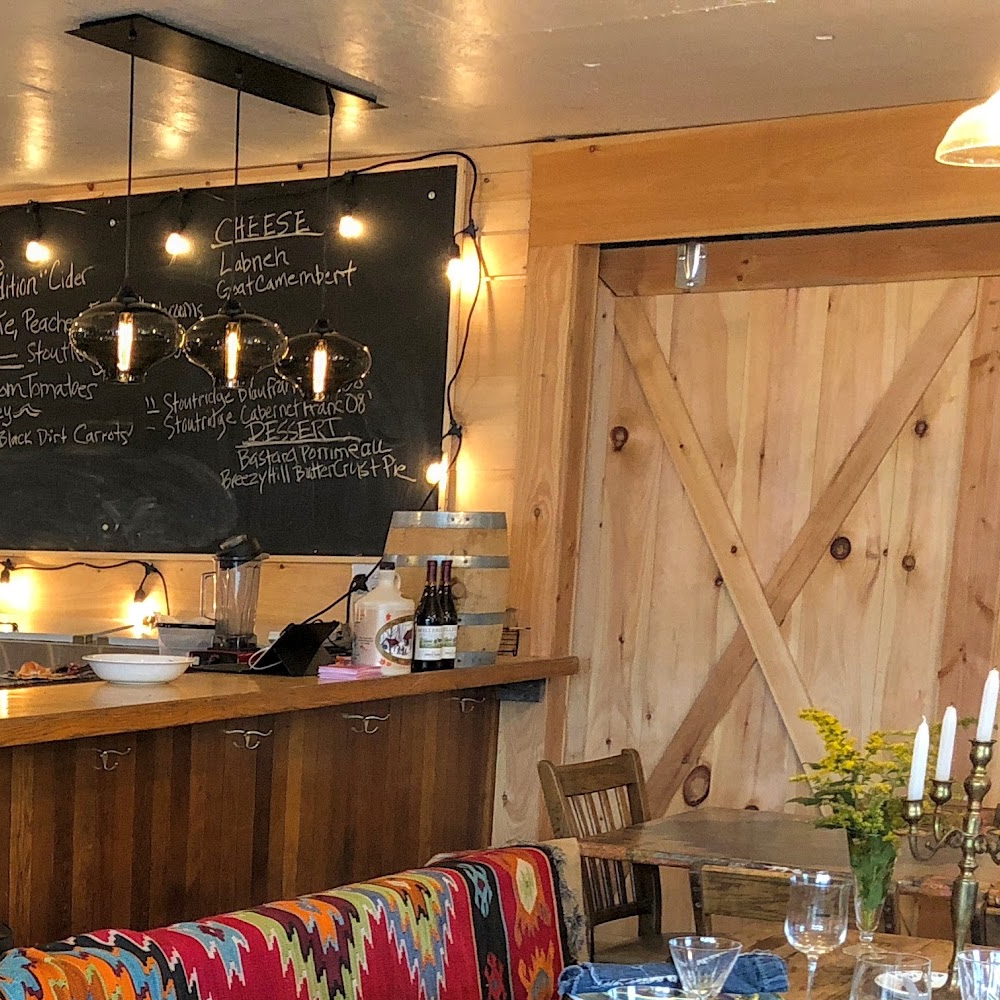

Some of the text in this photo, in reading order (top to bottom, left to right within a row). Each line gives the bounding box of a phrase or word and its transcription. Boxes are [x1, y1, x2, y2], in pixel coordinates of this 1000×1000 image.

[214, 210, 311, 244] CHEESE
[48, 259, 94, 291] Cider
[219, 247, 290, 277] Labneh
[20, 372, 98, 401] Tomatoes
[240, 401, 300, 423] Cabernet
[37, 427, 68, 445] Dirt
[244, 417, 342, 442] DESSERT
[236, 438, 393, 471] Bastard Pommeau
[219, 467, 269, 495] Breezy
[267, 464, 291, 484] Hill
[381, 454, 416, 483] Pie
